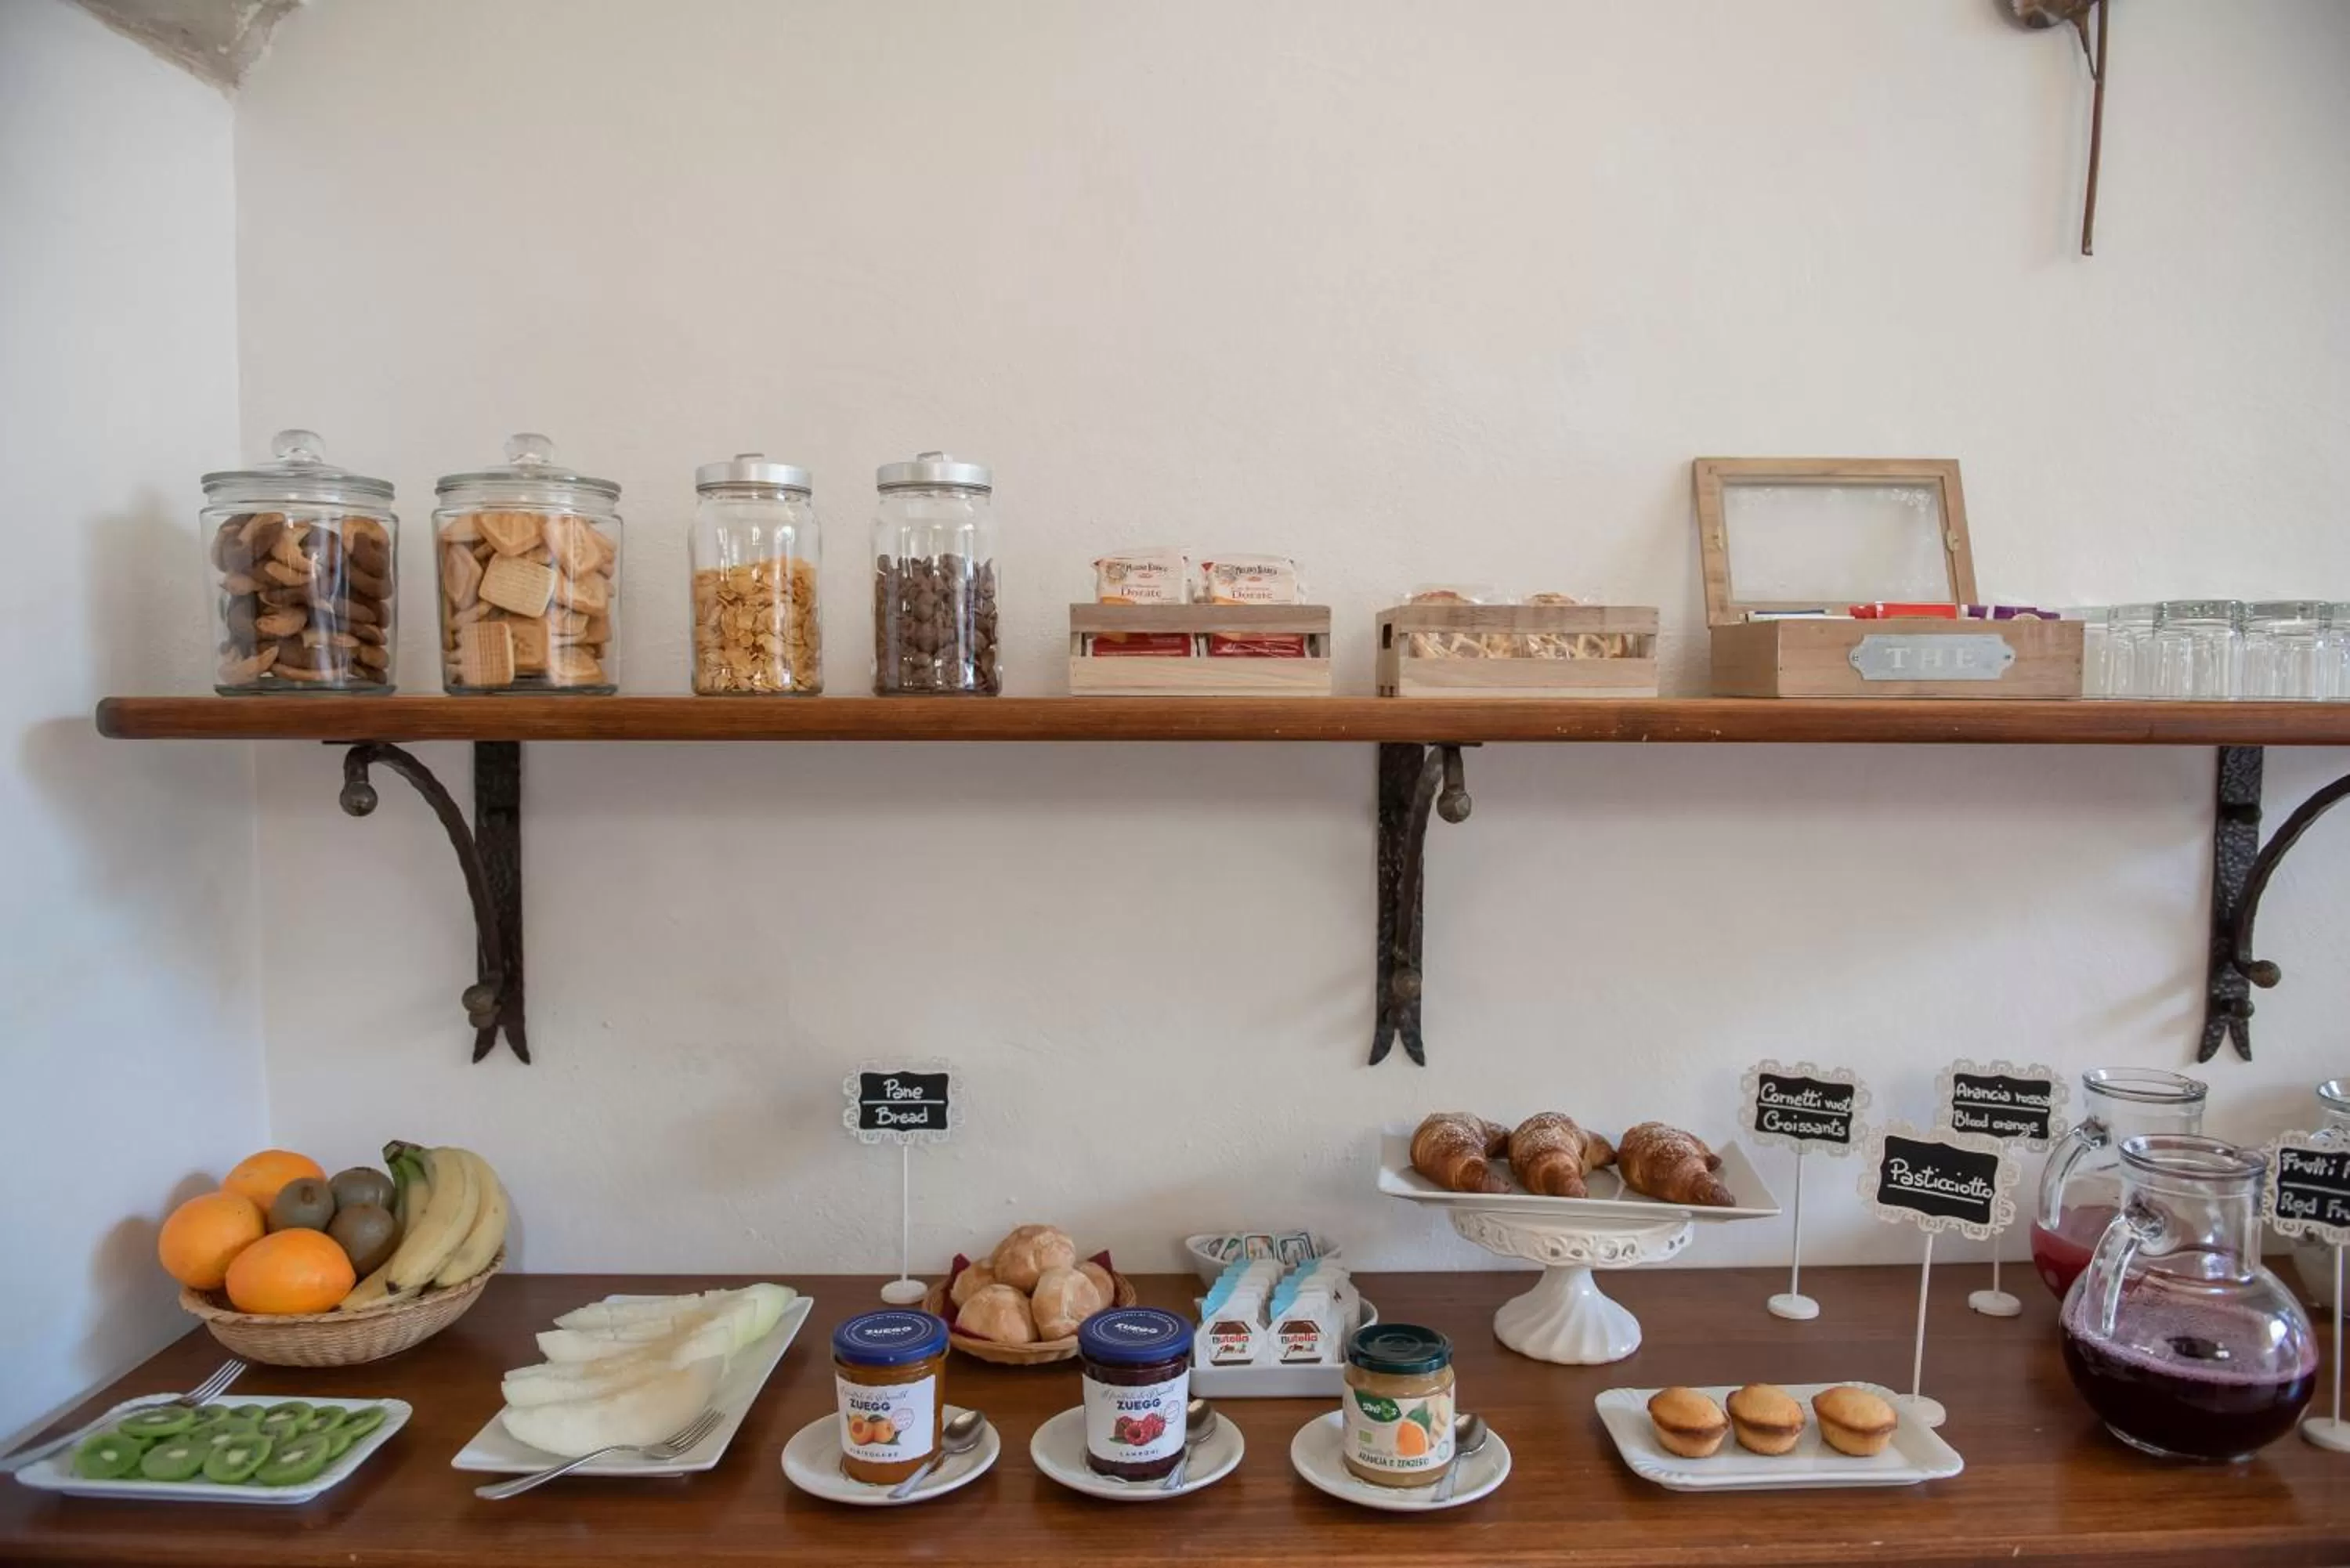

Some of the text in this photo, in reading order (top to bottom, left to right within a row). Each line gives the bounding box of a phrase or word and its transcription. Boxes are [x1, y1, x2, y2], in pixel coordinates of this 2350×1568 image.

[1885, 647, 1976, 669] THE
[884, 1078, 924, 1099] Pane
[1761, 1082, 1822, 1107] Cornetti
[1956, 1082, 2011, 1102] Arancia
[875, 1106, 928, 1125] Bread
[1763, 1110, 1846, 1136] Croissants
[1954, 1110, 2039, 1137] Blood orange
[2282, 1152, 2337, 1176] Frutti
[1889, 1158, 1994, 1198] Pasticciotto
[2280, 1191, 2318, 1215] Red
[1212, 1333, 1249, 1345] nutella
[1281, 1332, 1318, 1345] nutella
[849, 1398, 891, 1411] ZUEGG
[1116, 1398, 1161, 1411] ZUEGG
